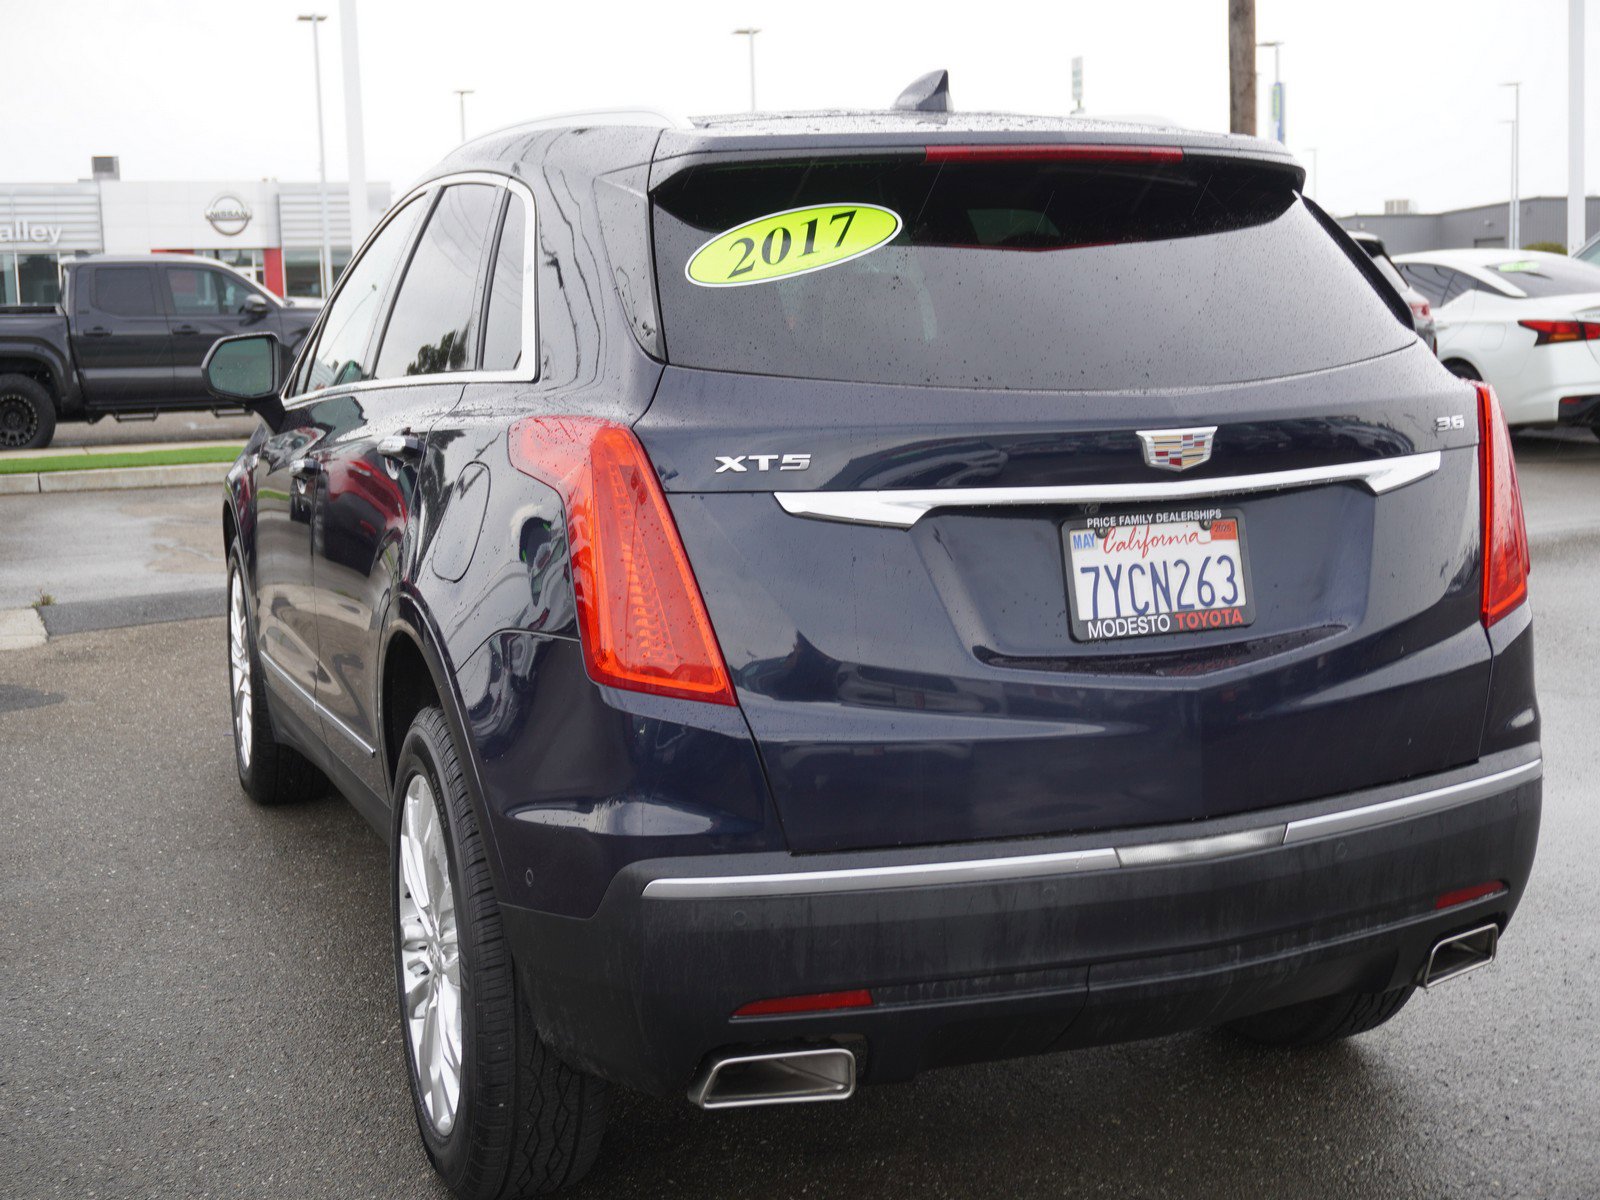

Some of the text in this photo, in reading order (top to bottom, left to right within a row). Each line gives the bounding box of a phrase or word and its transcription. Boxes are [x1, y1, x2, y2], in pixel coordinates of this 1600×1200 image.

[209, 210, 248, 219] NISSAN
[727, 209, 858, 279] 2017
[714, 453, 812, 473] XT5
[1086, 508, 1222, 529] PRICE FAMILY DEALERSHIPS
[1072, 531, 1096, 550] MAY
[1103, 524, 1204, 558] California
[1080, 555, 1238, 620] 7YCN263
[1088, 608, 1243, 638] MODESTO TOYOTA
